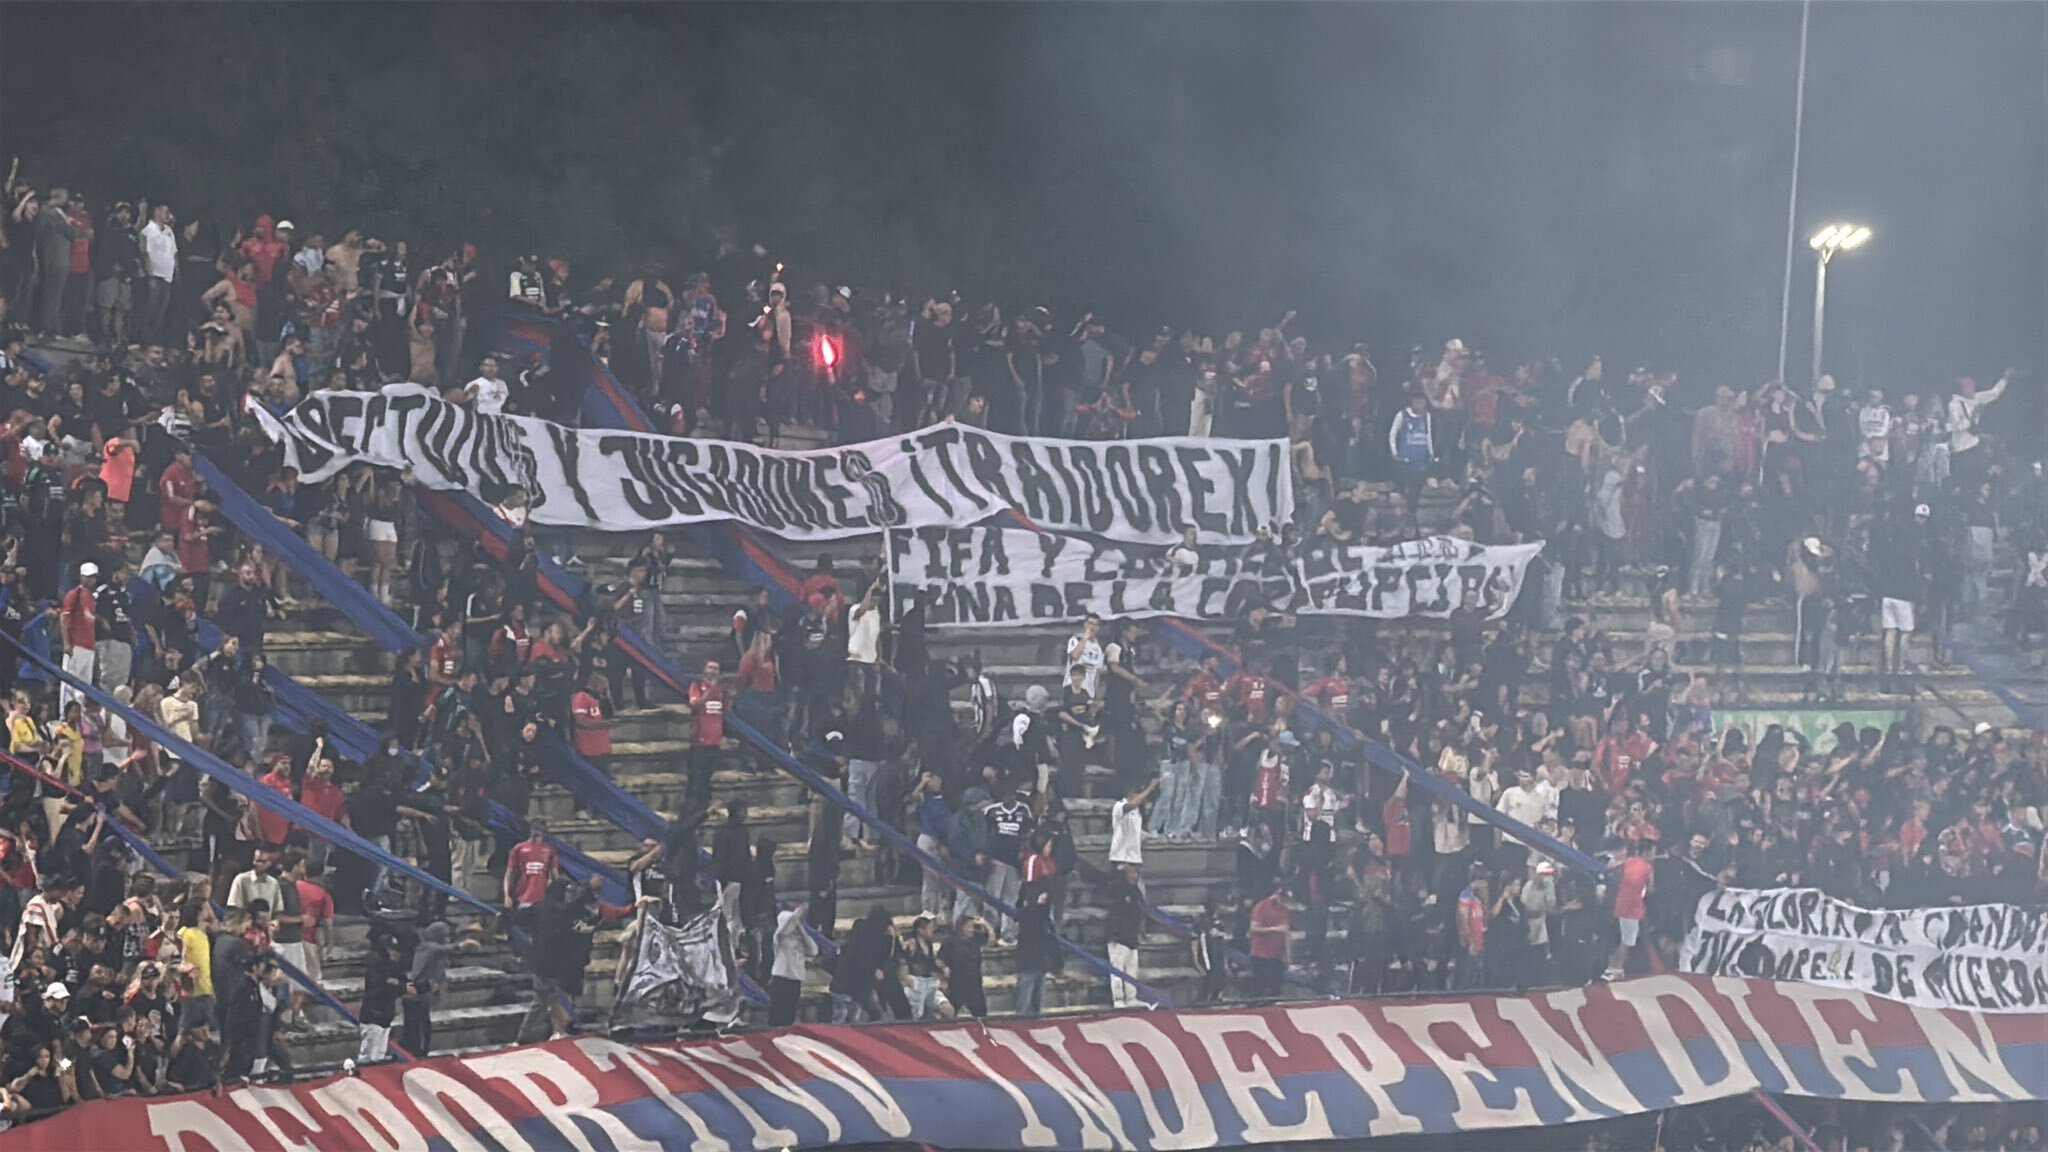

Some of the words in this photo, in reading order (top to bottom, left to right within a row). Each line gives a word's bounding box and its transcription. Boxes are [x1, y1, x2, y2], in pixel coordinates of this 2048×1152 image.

[546, 423, 600, 521] Y
[599, 436, 907, 530] JUGADORES
[892, 526, 1009, 578] FIFA
[1037, 532, 1065, 577] Y
[1031, 581, 1093, 618] DE
[1750, 892, 1852, 938] GLORIA
[1871, 952, 1917, 998] DE
[1922, 953, 2048, 1008] MIERDA
